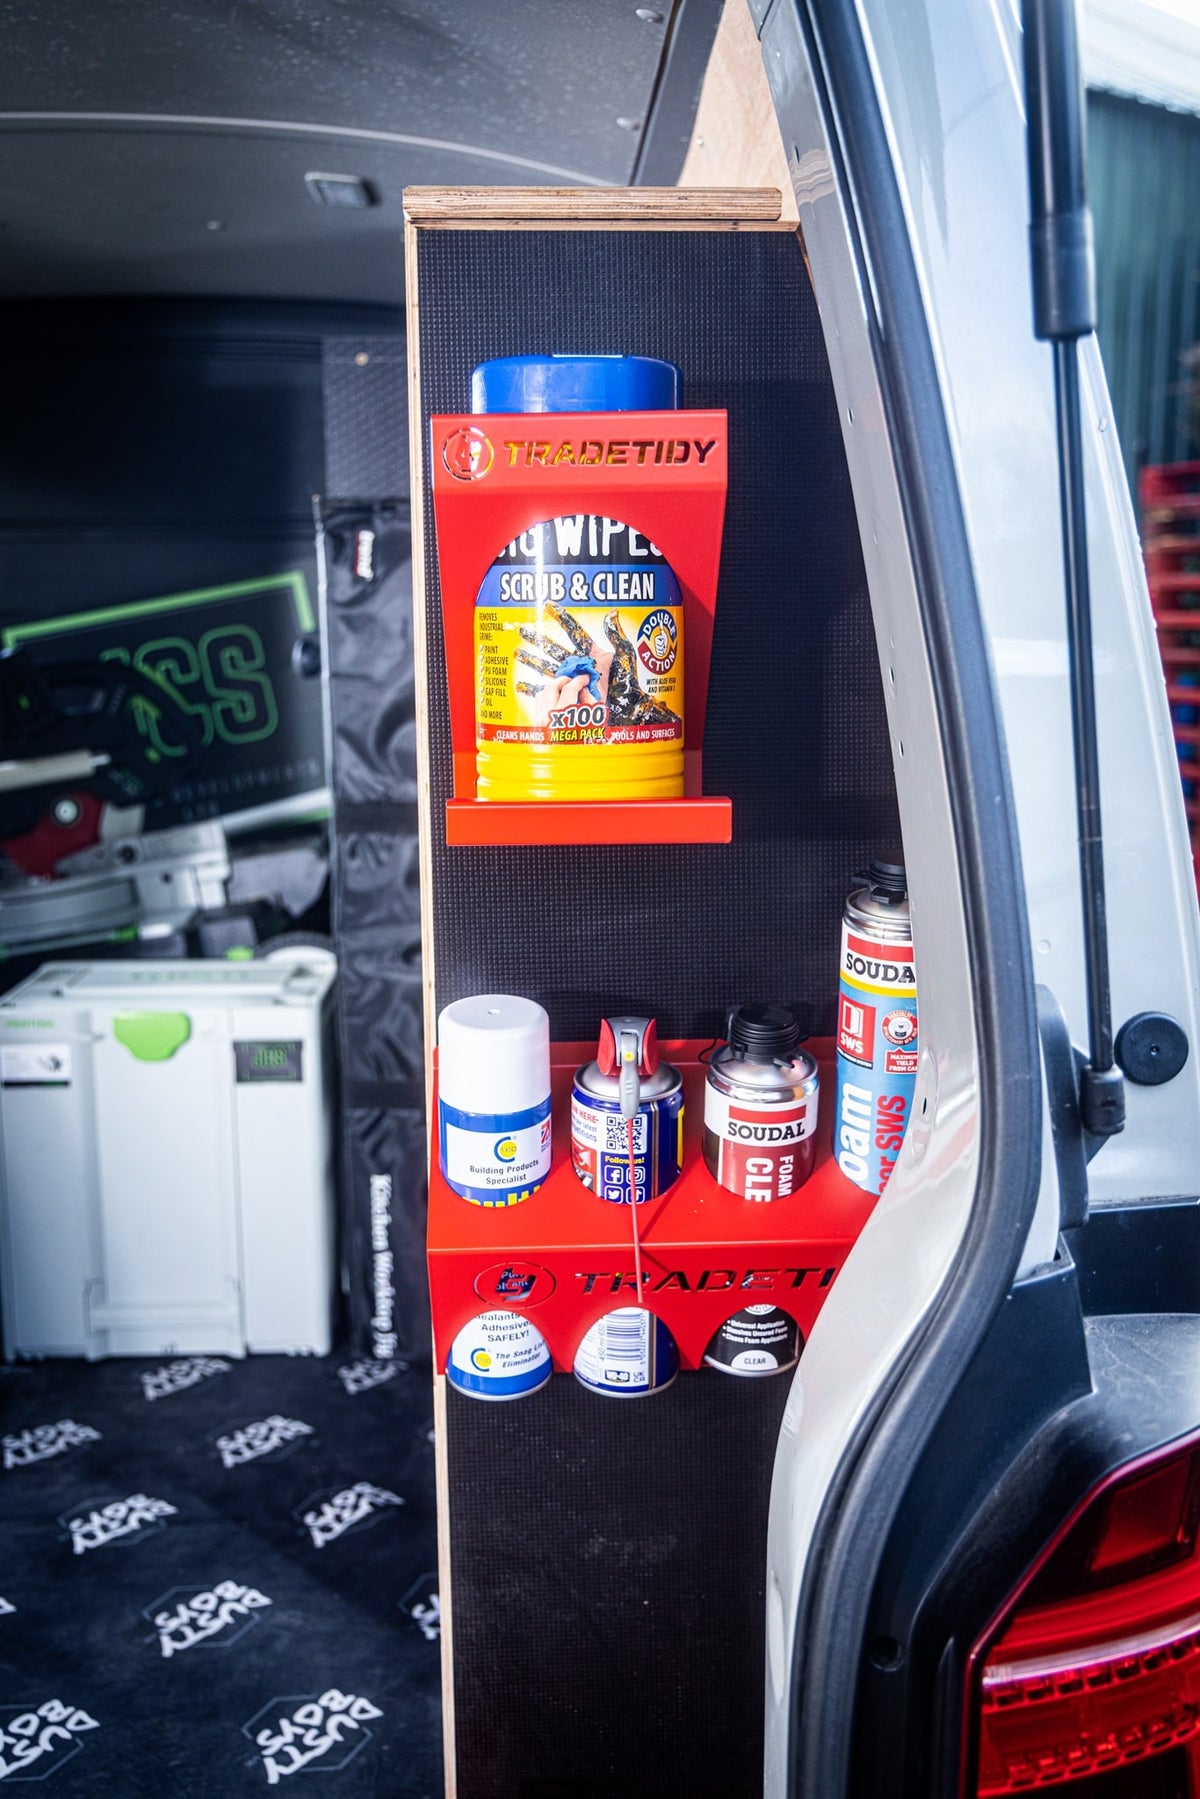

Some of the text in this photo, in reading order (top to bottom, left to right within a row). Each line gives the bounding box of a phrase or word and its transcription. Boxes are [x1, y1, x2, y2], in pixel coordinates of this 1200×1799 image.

[504, 440, 717, 466] TRADETIDY
[500, 572, 655, 601] SCRUB & CLEAN
[642, 611, 676, 638] DOUBLE
[485, 645, 499, 654] PAINT
[485, 657, 509, 666] ADHESIVE
[641, 650, 676, 673] ACTION
[492, 667, 508, 676] FOAM
[485, 677, 507, 686] SILICONE
[485, 687, 506, 697] GAP FILL
[488, 710, 502, 720] MORE
[551, 706, 606, 728] x100
[496, 729, 518, 740] CLEANS
[518, 731, 545, 741] HANDS
[550, 727, 605, 742] MEGA PACK
[636, 729, 651, 740] AND
[651, 727, 675, 739] SURFACES
[840, 1031, 865, 1055] SWS
[874, 1094, 906, 1151] SWS
[727, 1120, 806, 1142] SOUDAL
[469, 1158, 541, 1176] Building Products
[485, 1172, 527, 1187] Specialist
[777, 1154, 795, 1198] FOAM
[487, 1329, 530, 1343] SAFELY!
[513, 1347, 533, 1361] Snag
[743, 1357, 767, 1365] CLEAR
[263, 1697, 384, 1784] DUSTY
